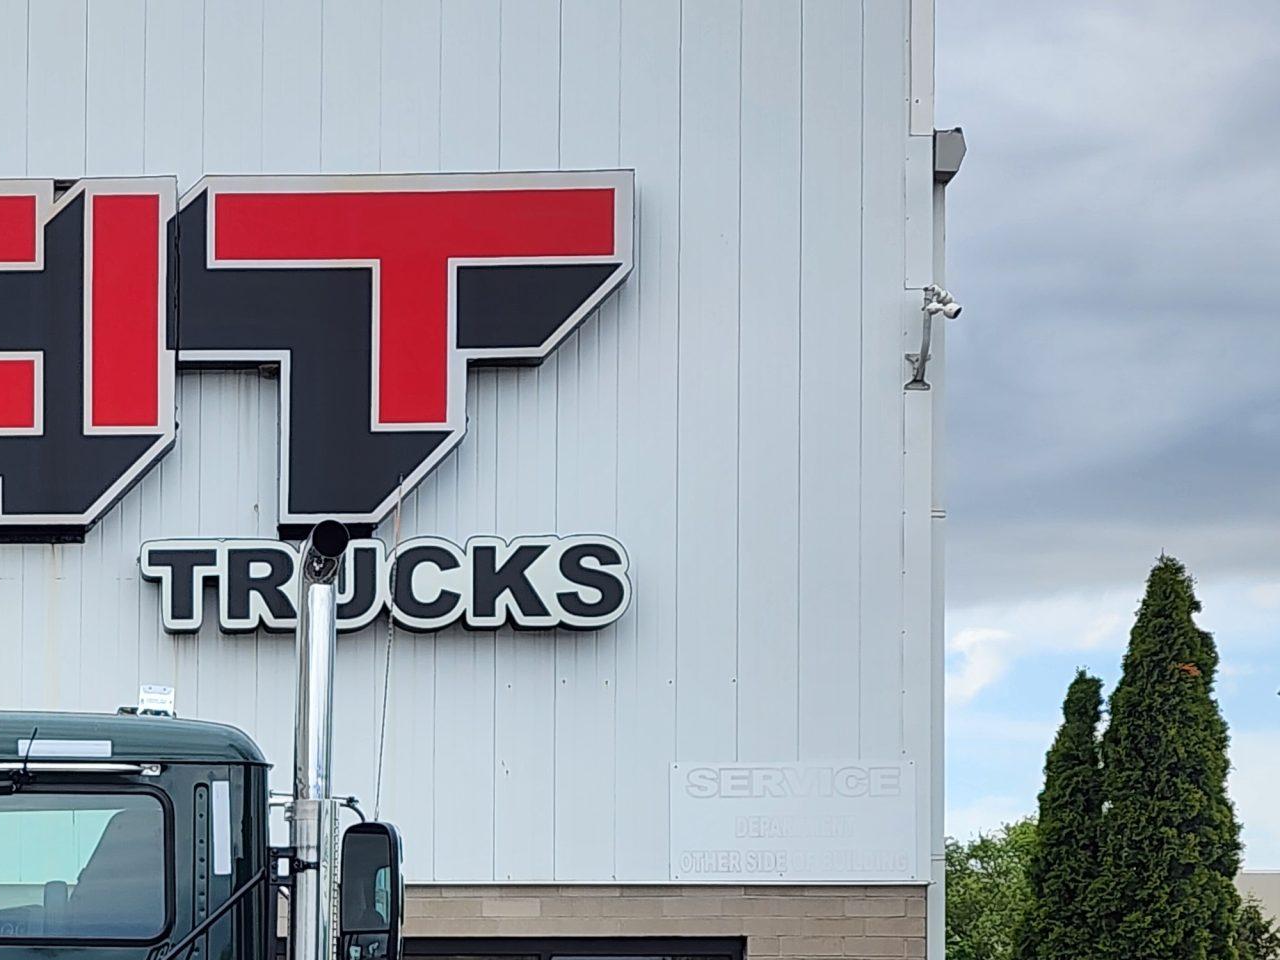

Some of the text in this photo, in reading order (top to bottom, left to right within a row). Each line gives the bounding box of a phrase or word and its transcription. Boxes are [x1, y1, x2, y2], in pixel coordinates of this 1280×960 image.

[147, 543, 626, 620] TRUCKS
[686, 767, 901, 798] SERVICE
[680, 850, 741, 873] OTHER
[746, 850, 788, 873] SIDE
